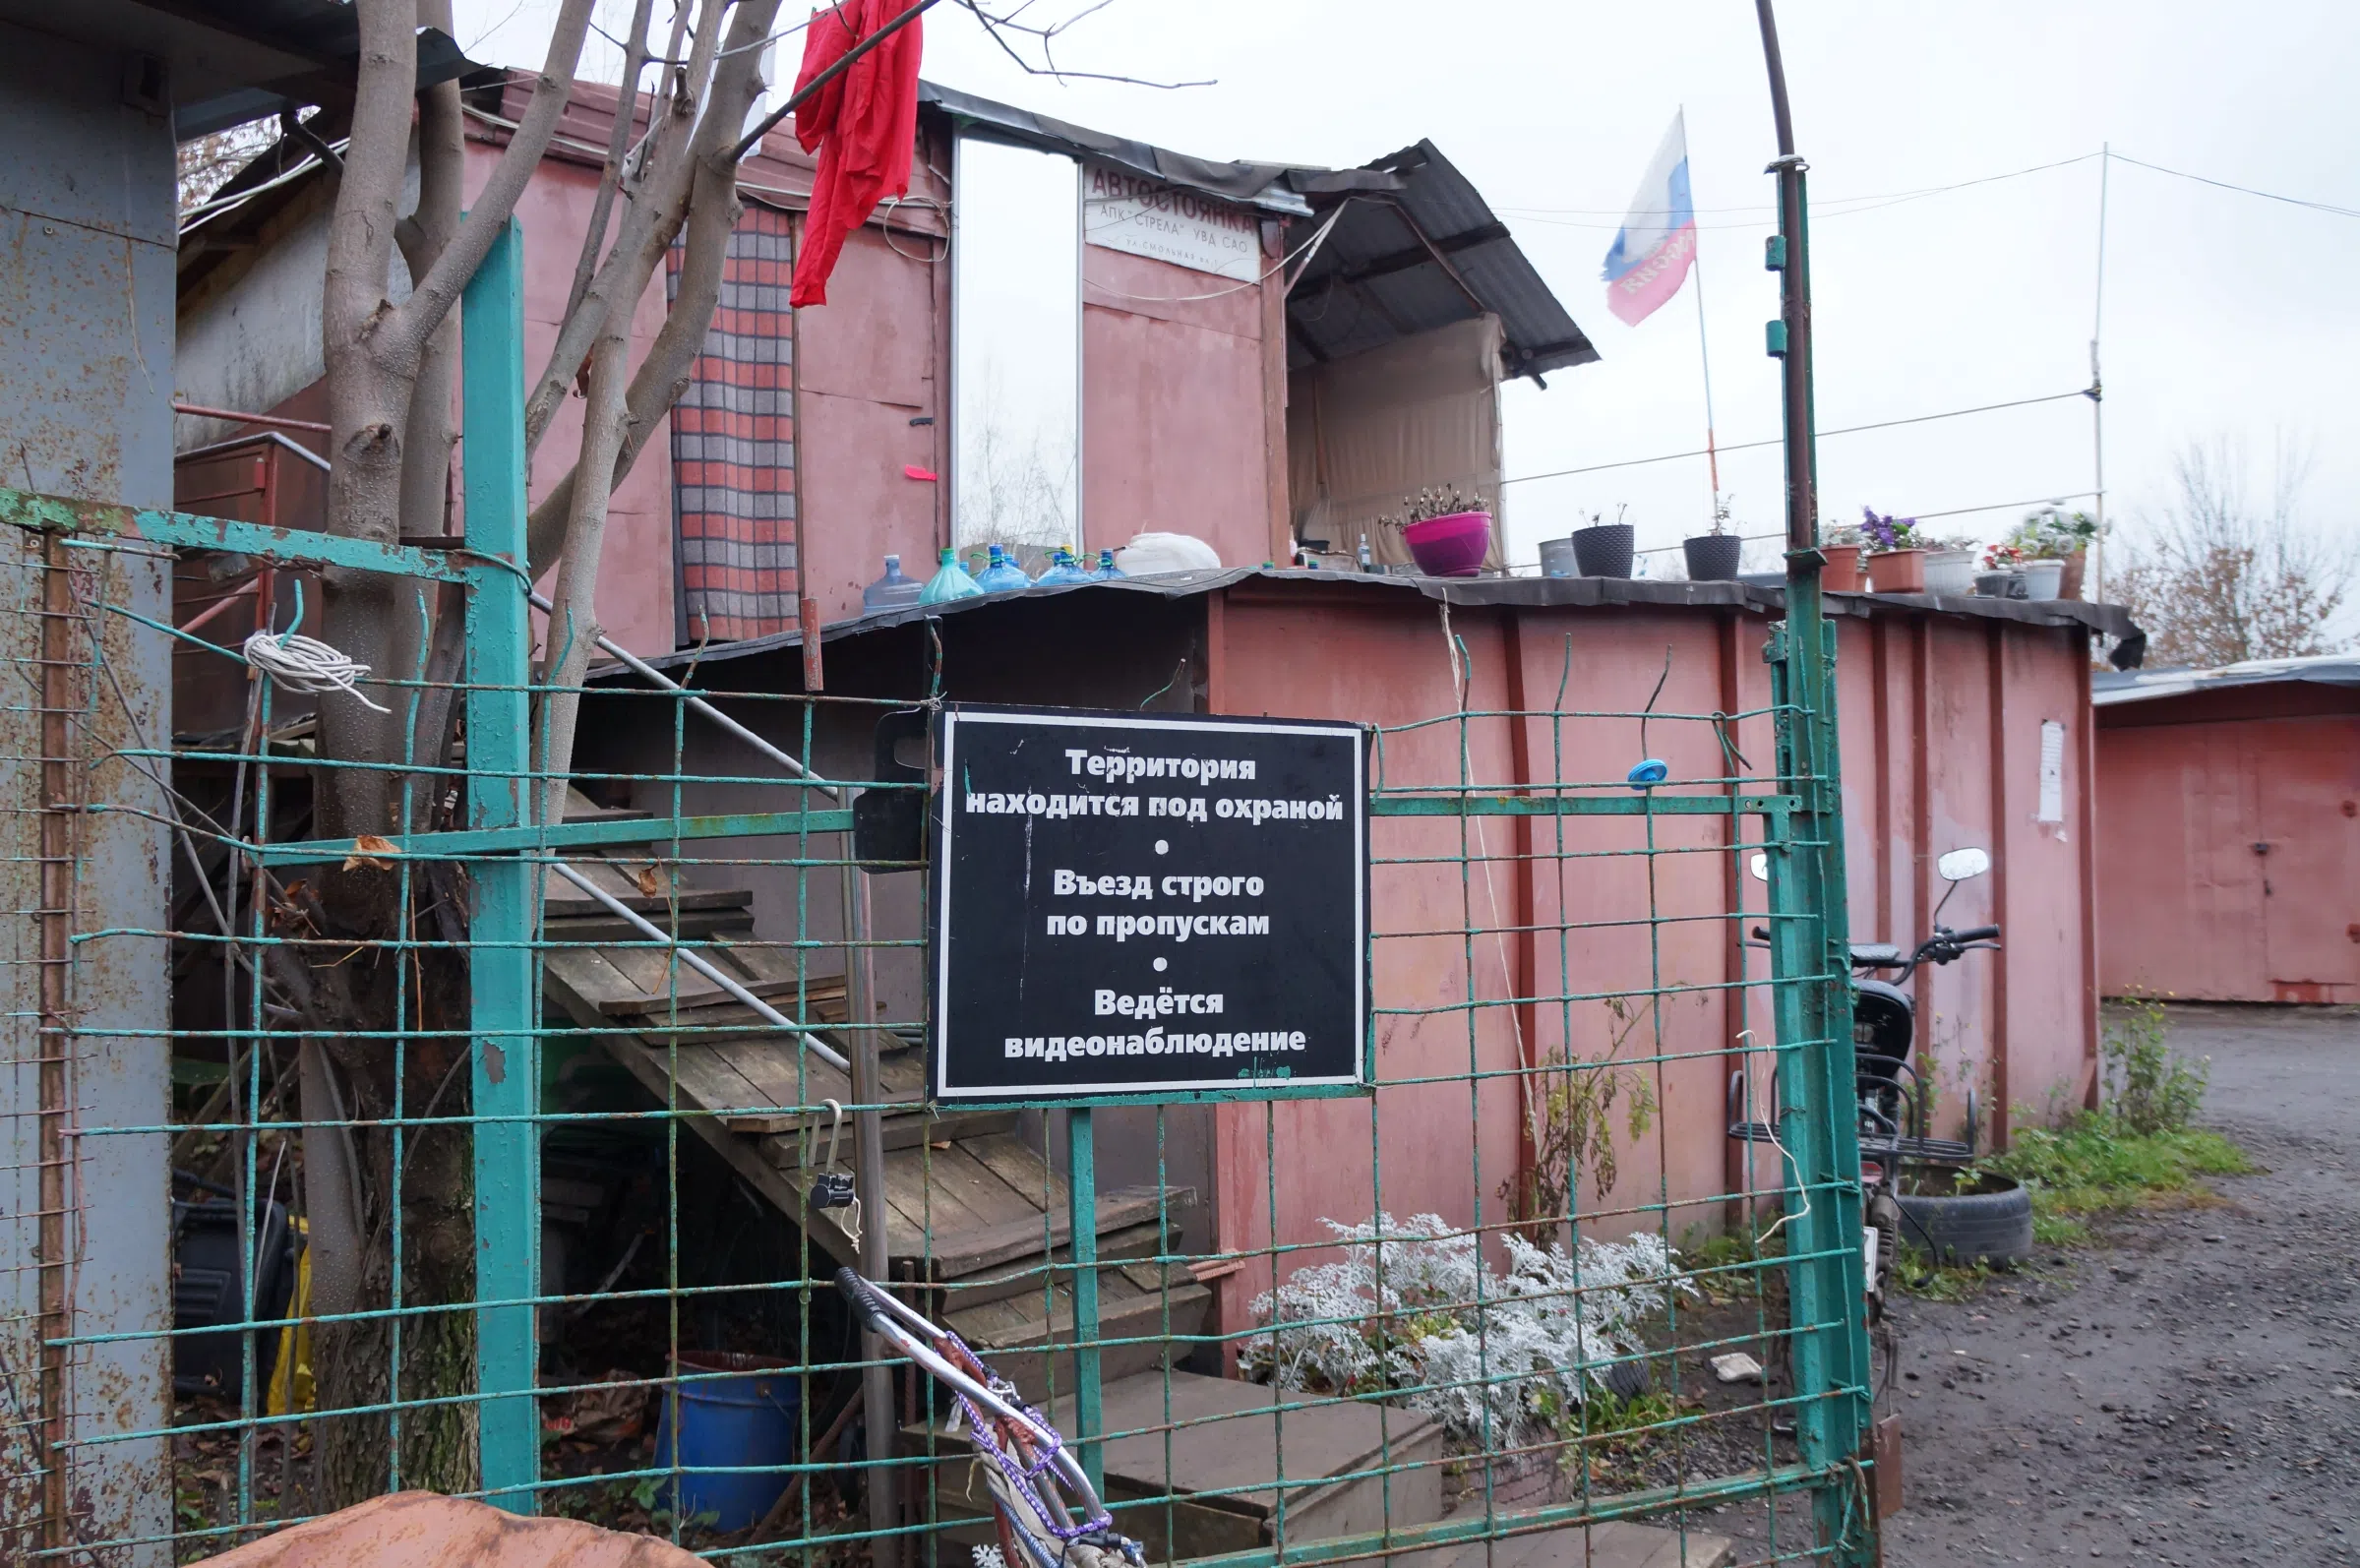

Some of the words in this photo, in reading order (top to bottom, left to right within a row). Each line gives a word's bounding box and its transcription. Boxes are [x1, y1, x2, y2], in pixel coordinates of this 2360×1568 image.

[1100, 205, 1124, 220] АПК
[1222, 236, 1247, 253] САО
[1064, 748, 1256, 786] Территория
[965, 790, 1139, 820] находится
[1148, 797, 1208, 822] под
[1215, 794, 1343, 826] охраной
[1054, 869, 1154, 900] Въезд
[1161, 875, 1265, 903] строго
[1047, 915, 1088, 935] по
[1096, 915, 1270, 942] пропускам
[1094, 986, 1224, 1020] Ведётся
[1004, 1026, 1306, 1062] видеонаблюдение
